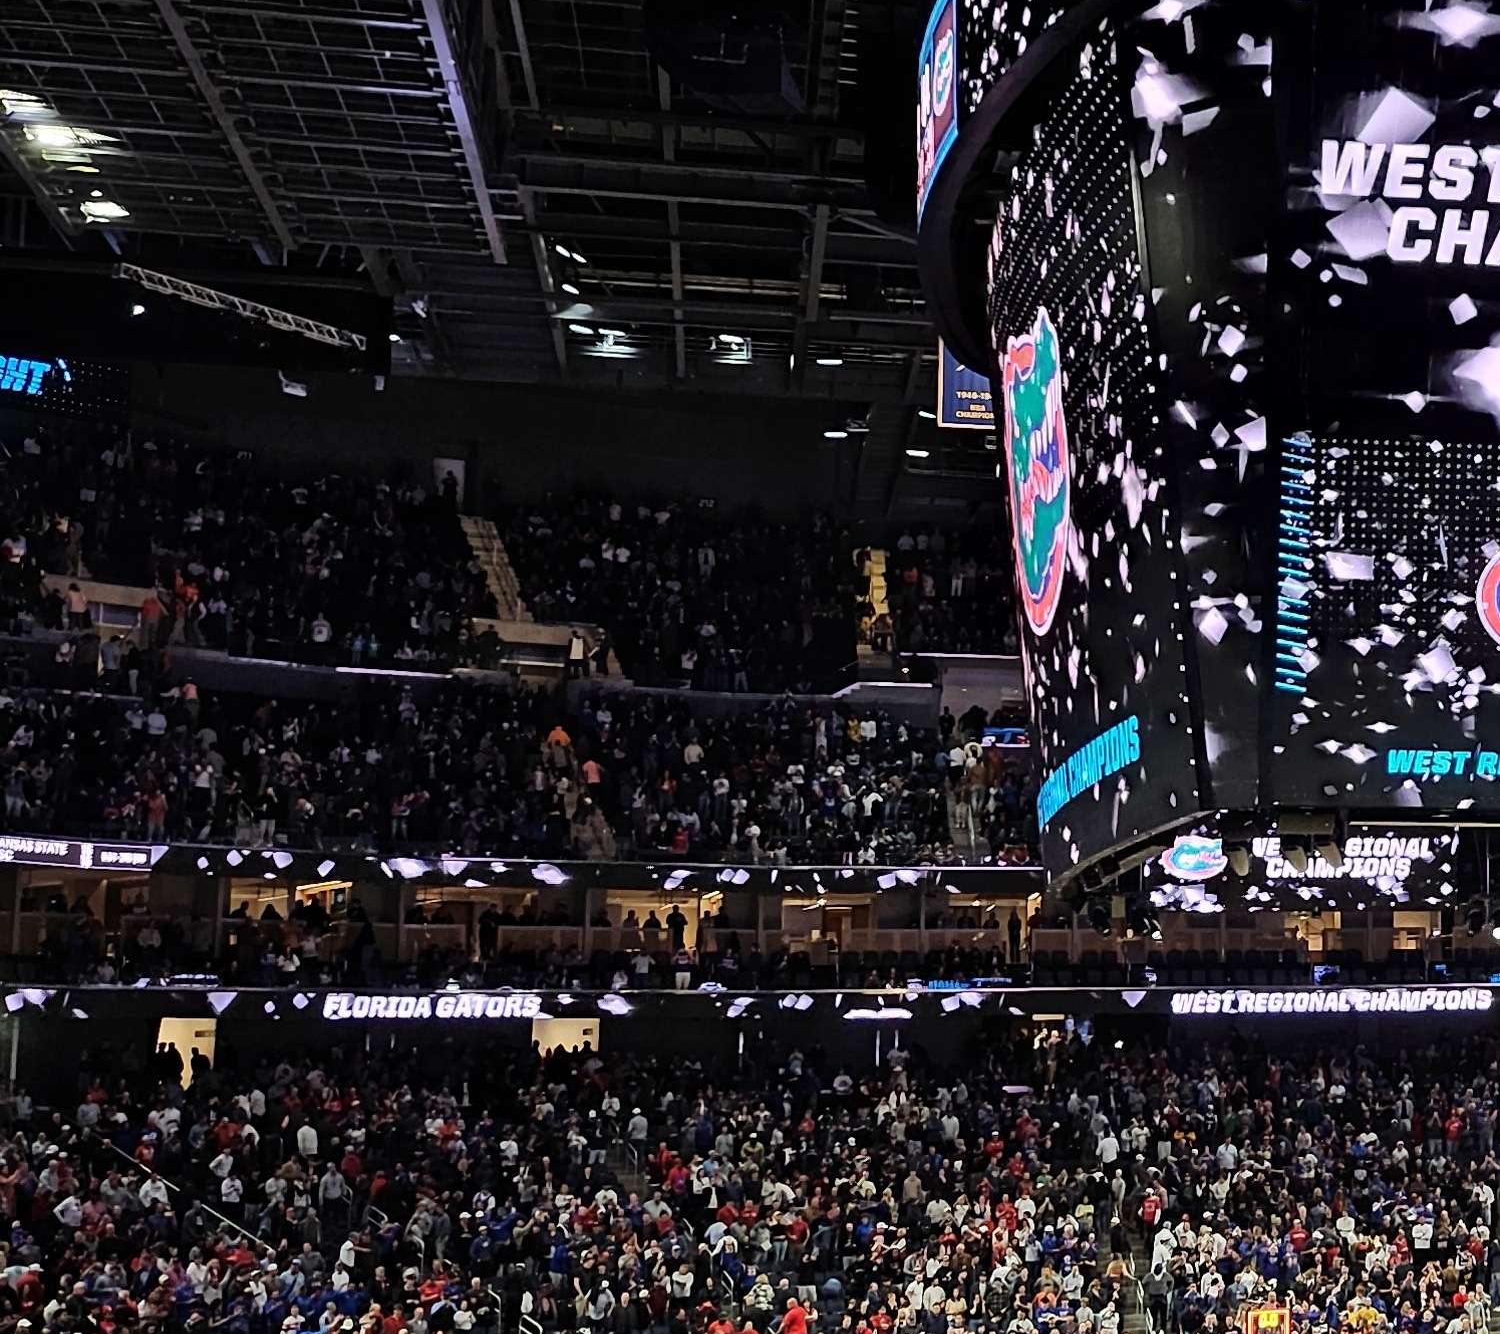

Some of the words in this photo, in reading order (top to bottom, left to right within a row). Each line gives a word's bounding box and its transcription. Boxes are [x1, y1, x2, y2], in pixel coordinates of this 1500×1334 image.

[1067, 714, 1141, 798] CHAMPIONS
[1387, 750, 1471, 775] WEST
[34, 842, 68, 856] STATE
[323, 994, 432, 1019] FLORIDA
[435, 995, 542, 1018] GATORS
[1171, 992, 1236, 1013] WEST
[1237, 991, 1349, 1013] REGIONAL
[1358, 990, 1493, 1012] CHAMPIONS
